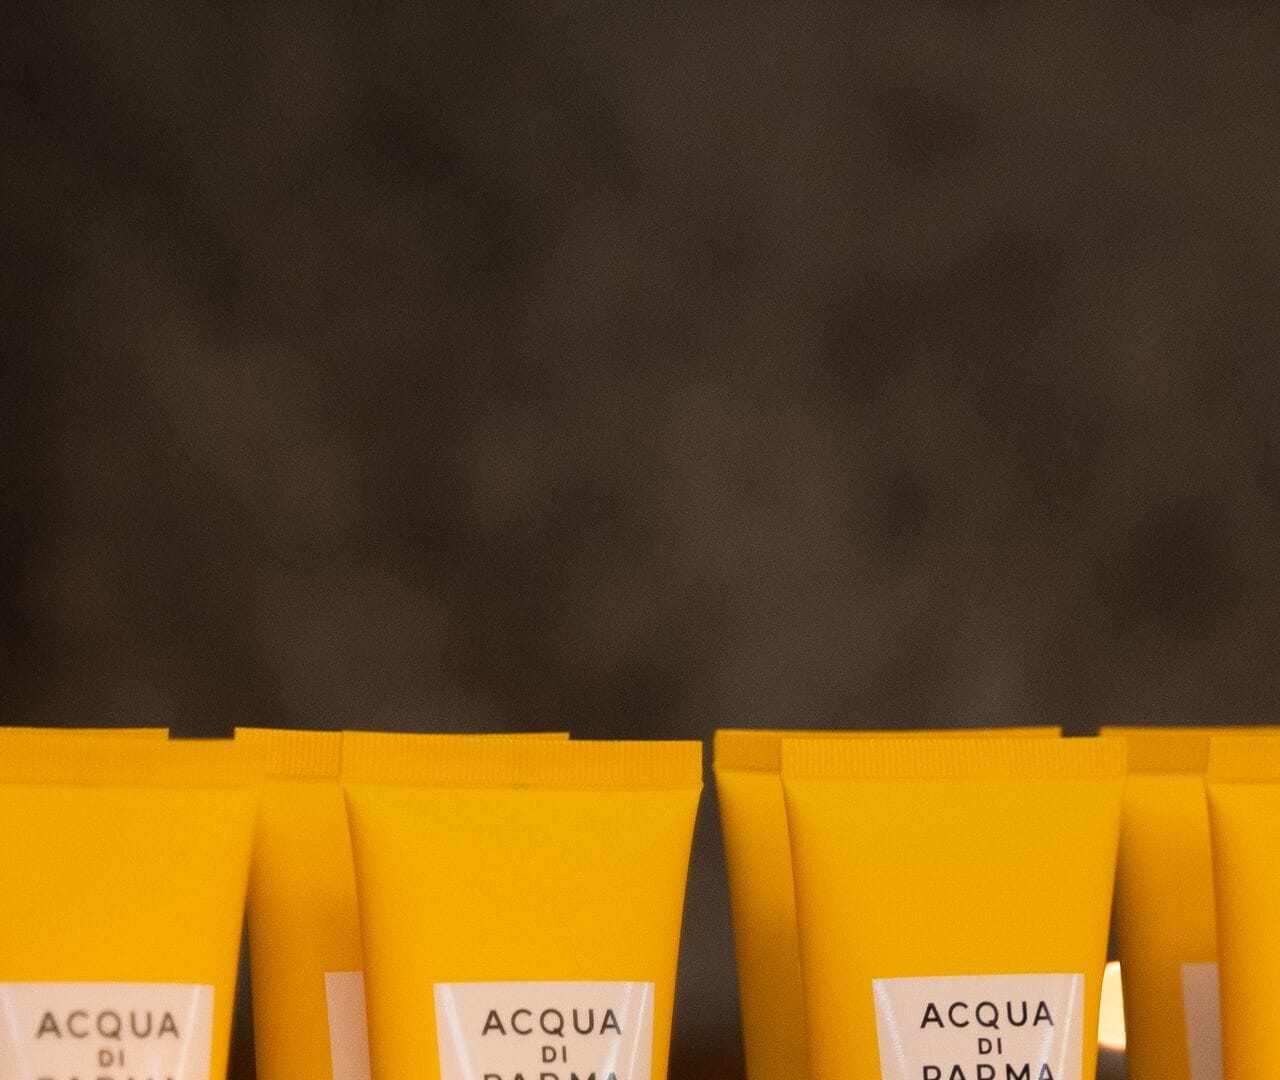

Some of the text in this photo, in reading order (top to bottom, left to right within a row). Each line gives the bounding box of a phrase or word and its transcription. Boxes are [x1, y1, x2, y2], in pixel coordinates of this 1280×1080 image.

[36, 1011, 180, 1041] ACQUA
[481, 1008, 622, 1036] ACQUA
[920, 1001, 1055, 1029] ACQUA
[541, 1046, 568, 1064] DI
[977, 1037, 1003, 1055] DI
[98, 1050, 125, 1068] DI
